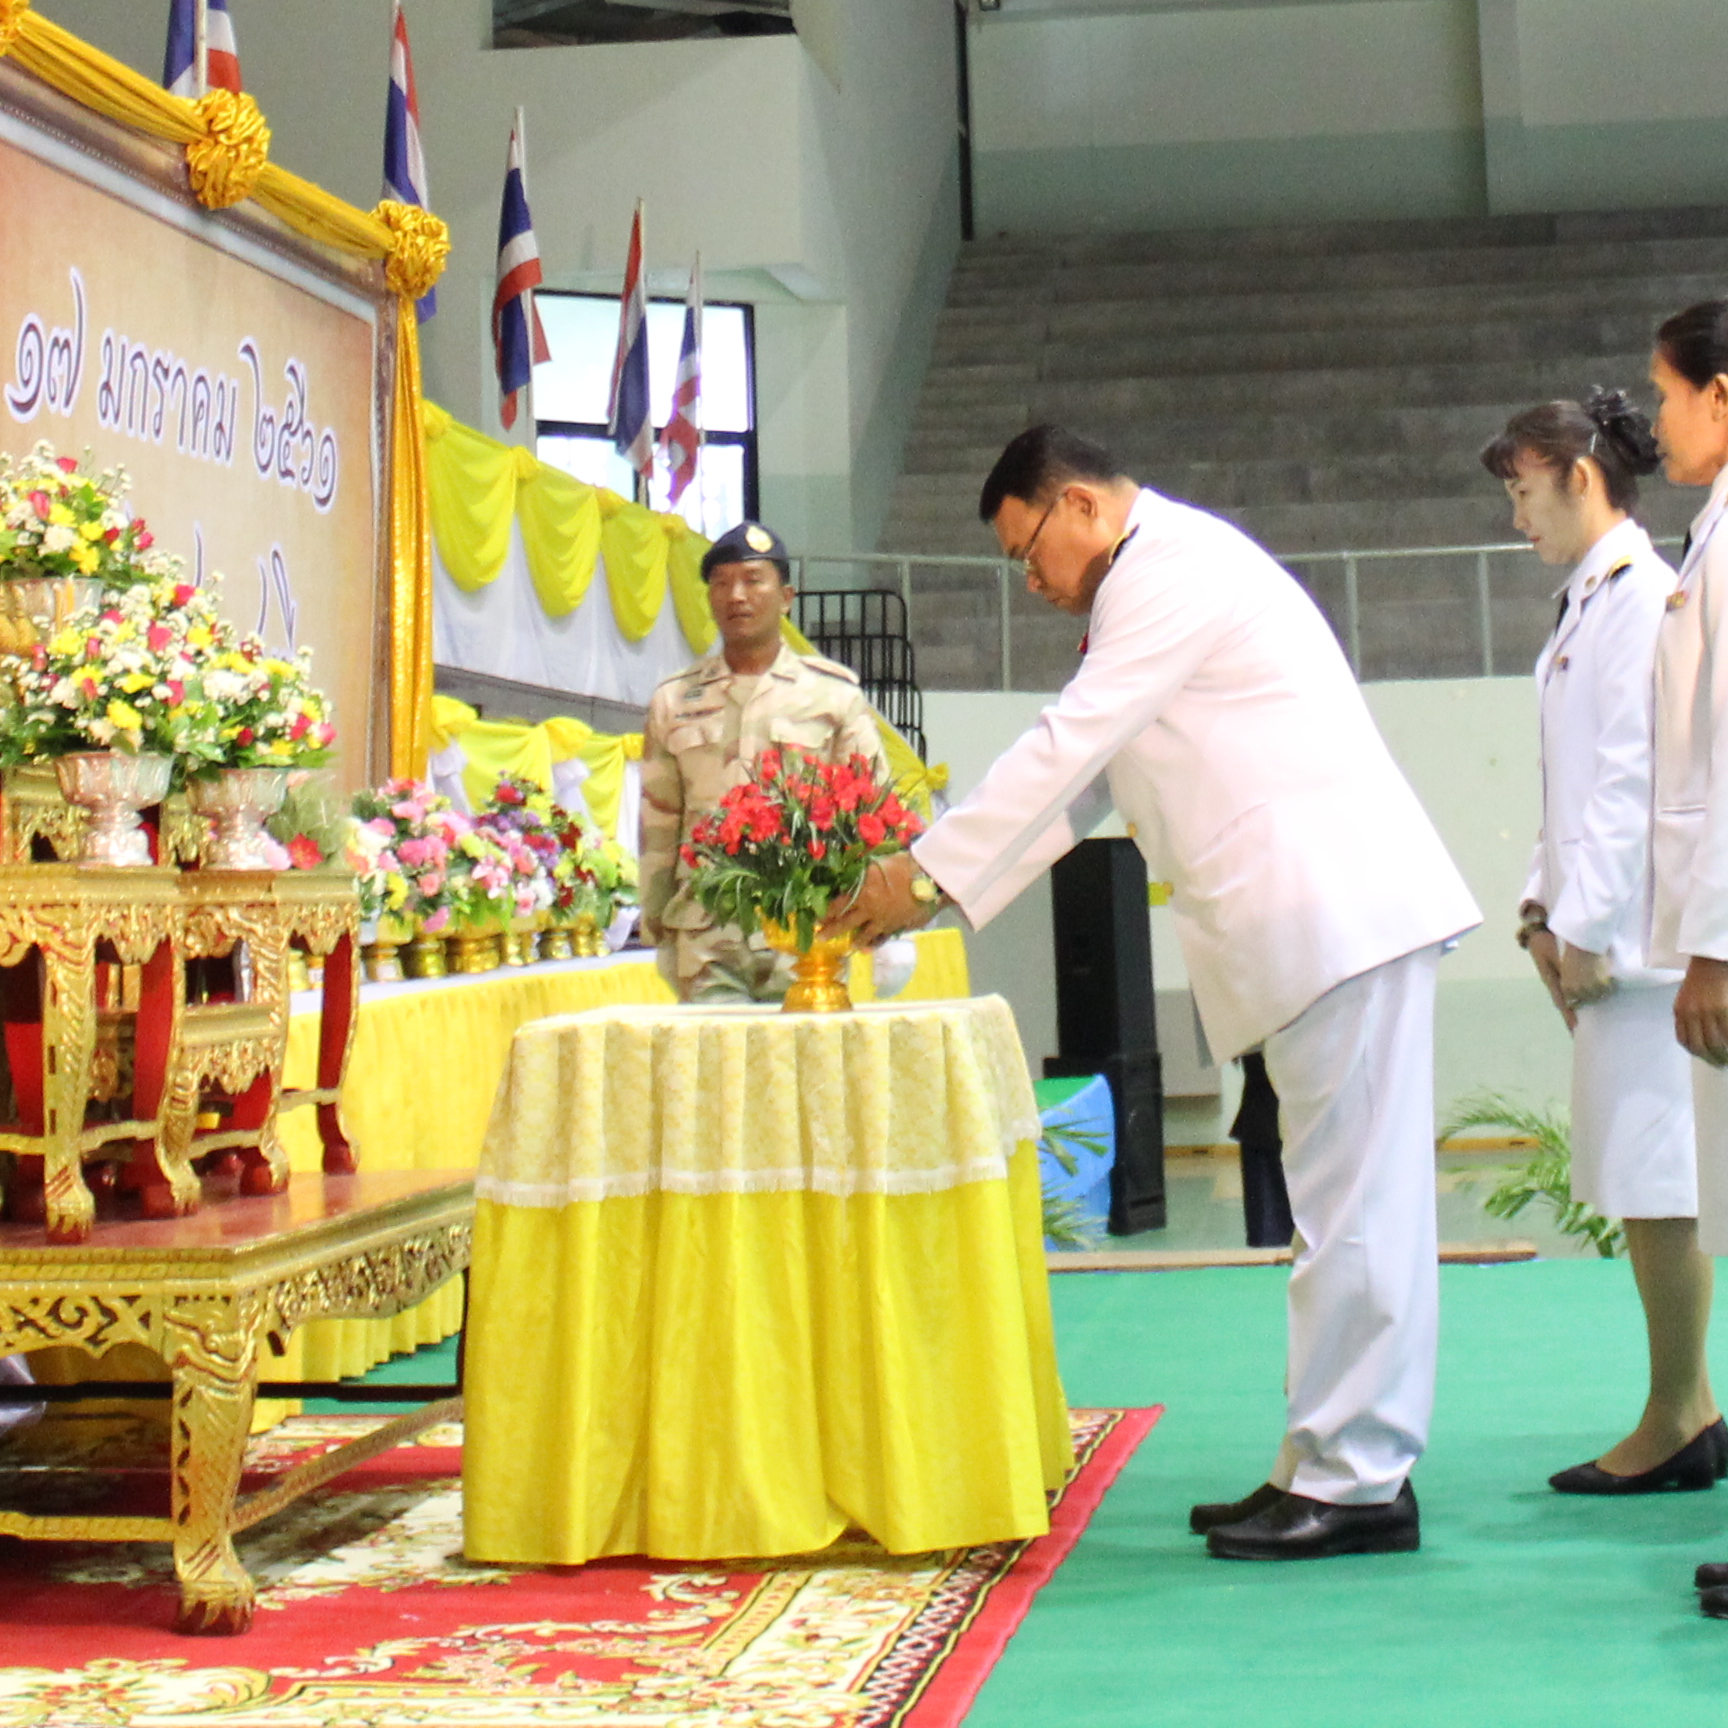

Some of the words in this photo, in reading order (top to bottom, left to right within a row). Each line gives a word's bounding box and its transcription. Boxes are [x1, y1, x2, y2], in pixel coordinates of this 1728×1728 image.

[8, 271, 85, 416] ๑๗
[98, 332, 236, 462] มกราคม
